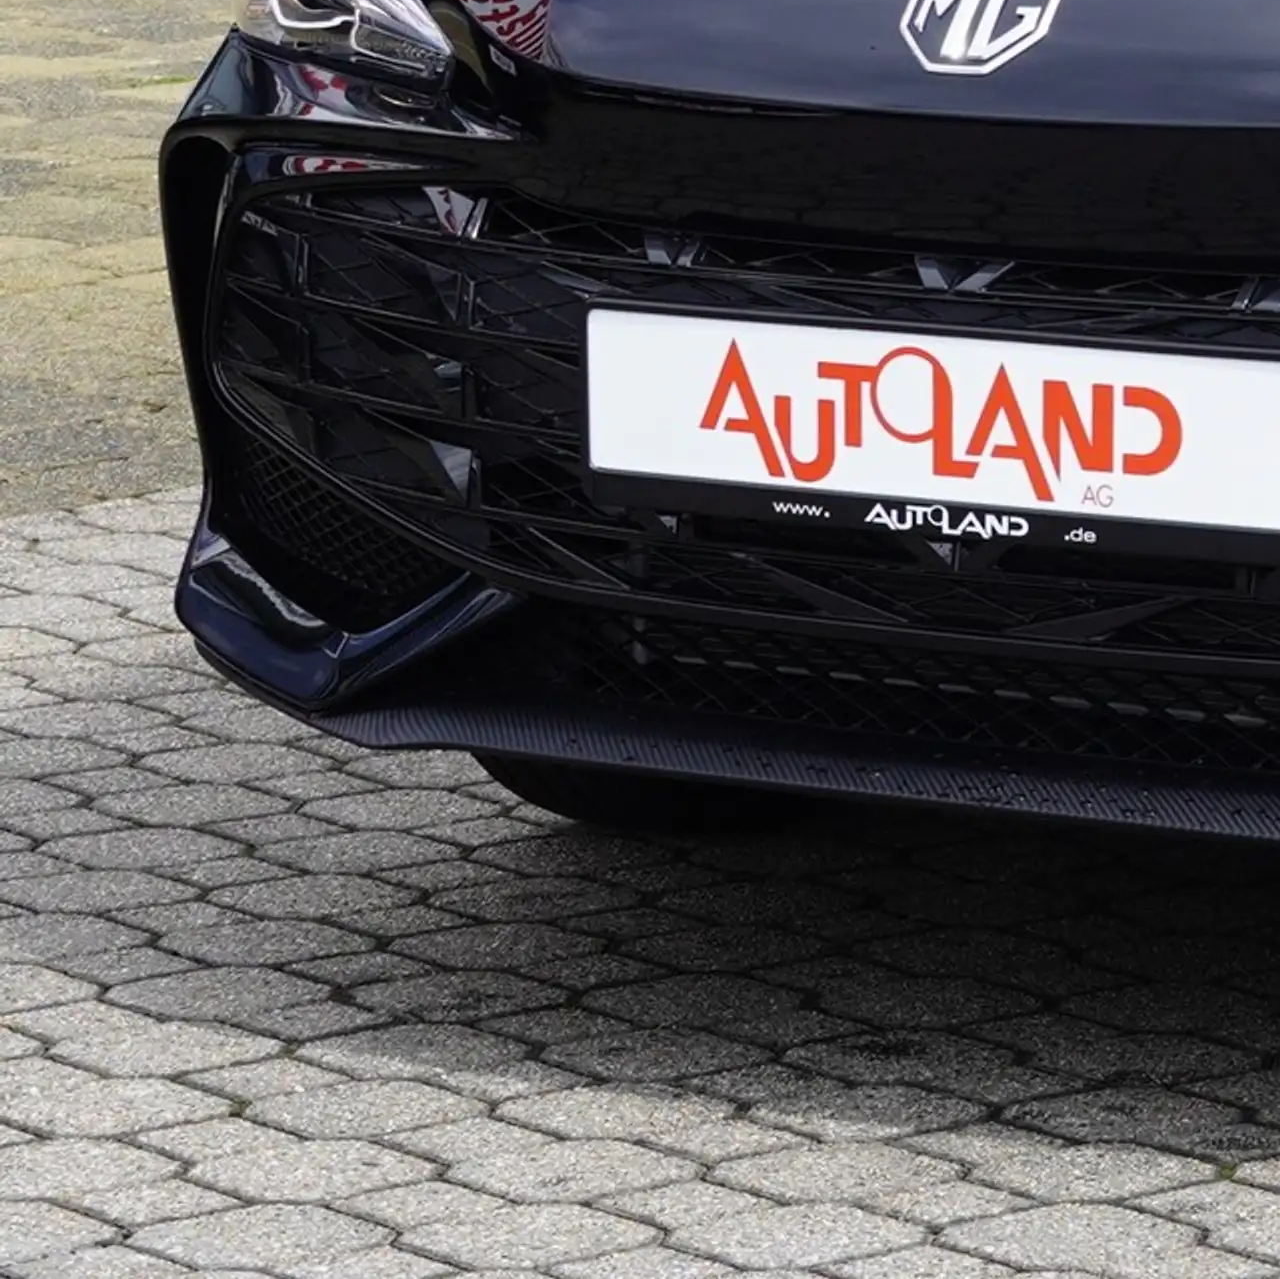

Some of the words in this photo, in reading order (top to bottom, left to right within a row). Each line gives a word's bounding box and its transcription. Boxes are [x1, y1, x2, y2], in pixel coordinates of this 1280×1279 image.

[699, 338, 1183, 502] AUTOLAND
[1081, 484, 1114, 508] AG
[772, 500, 830, 518] www.
[864, 503, 1029, 539] AUTOLAND
[1064, 527, 1097, 544] .de
